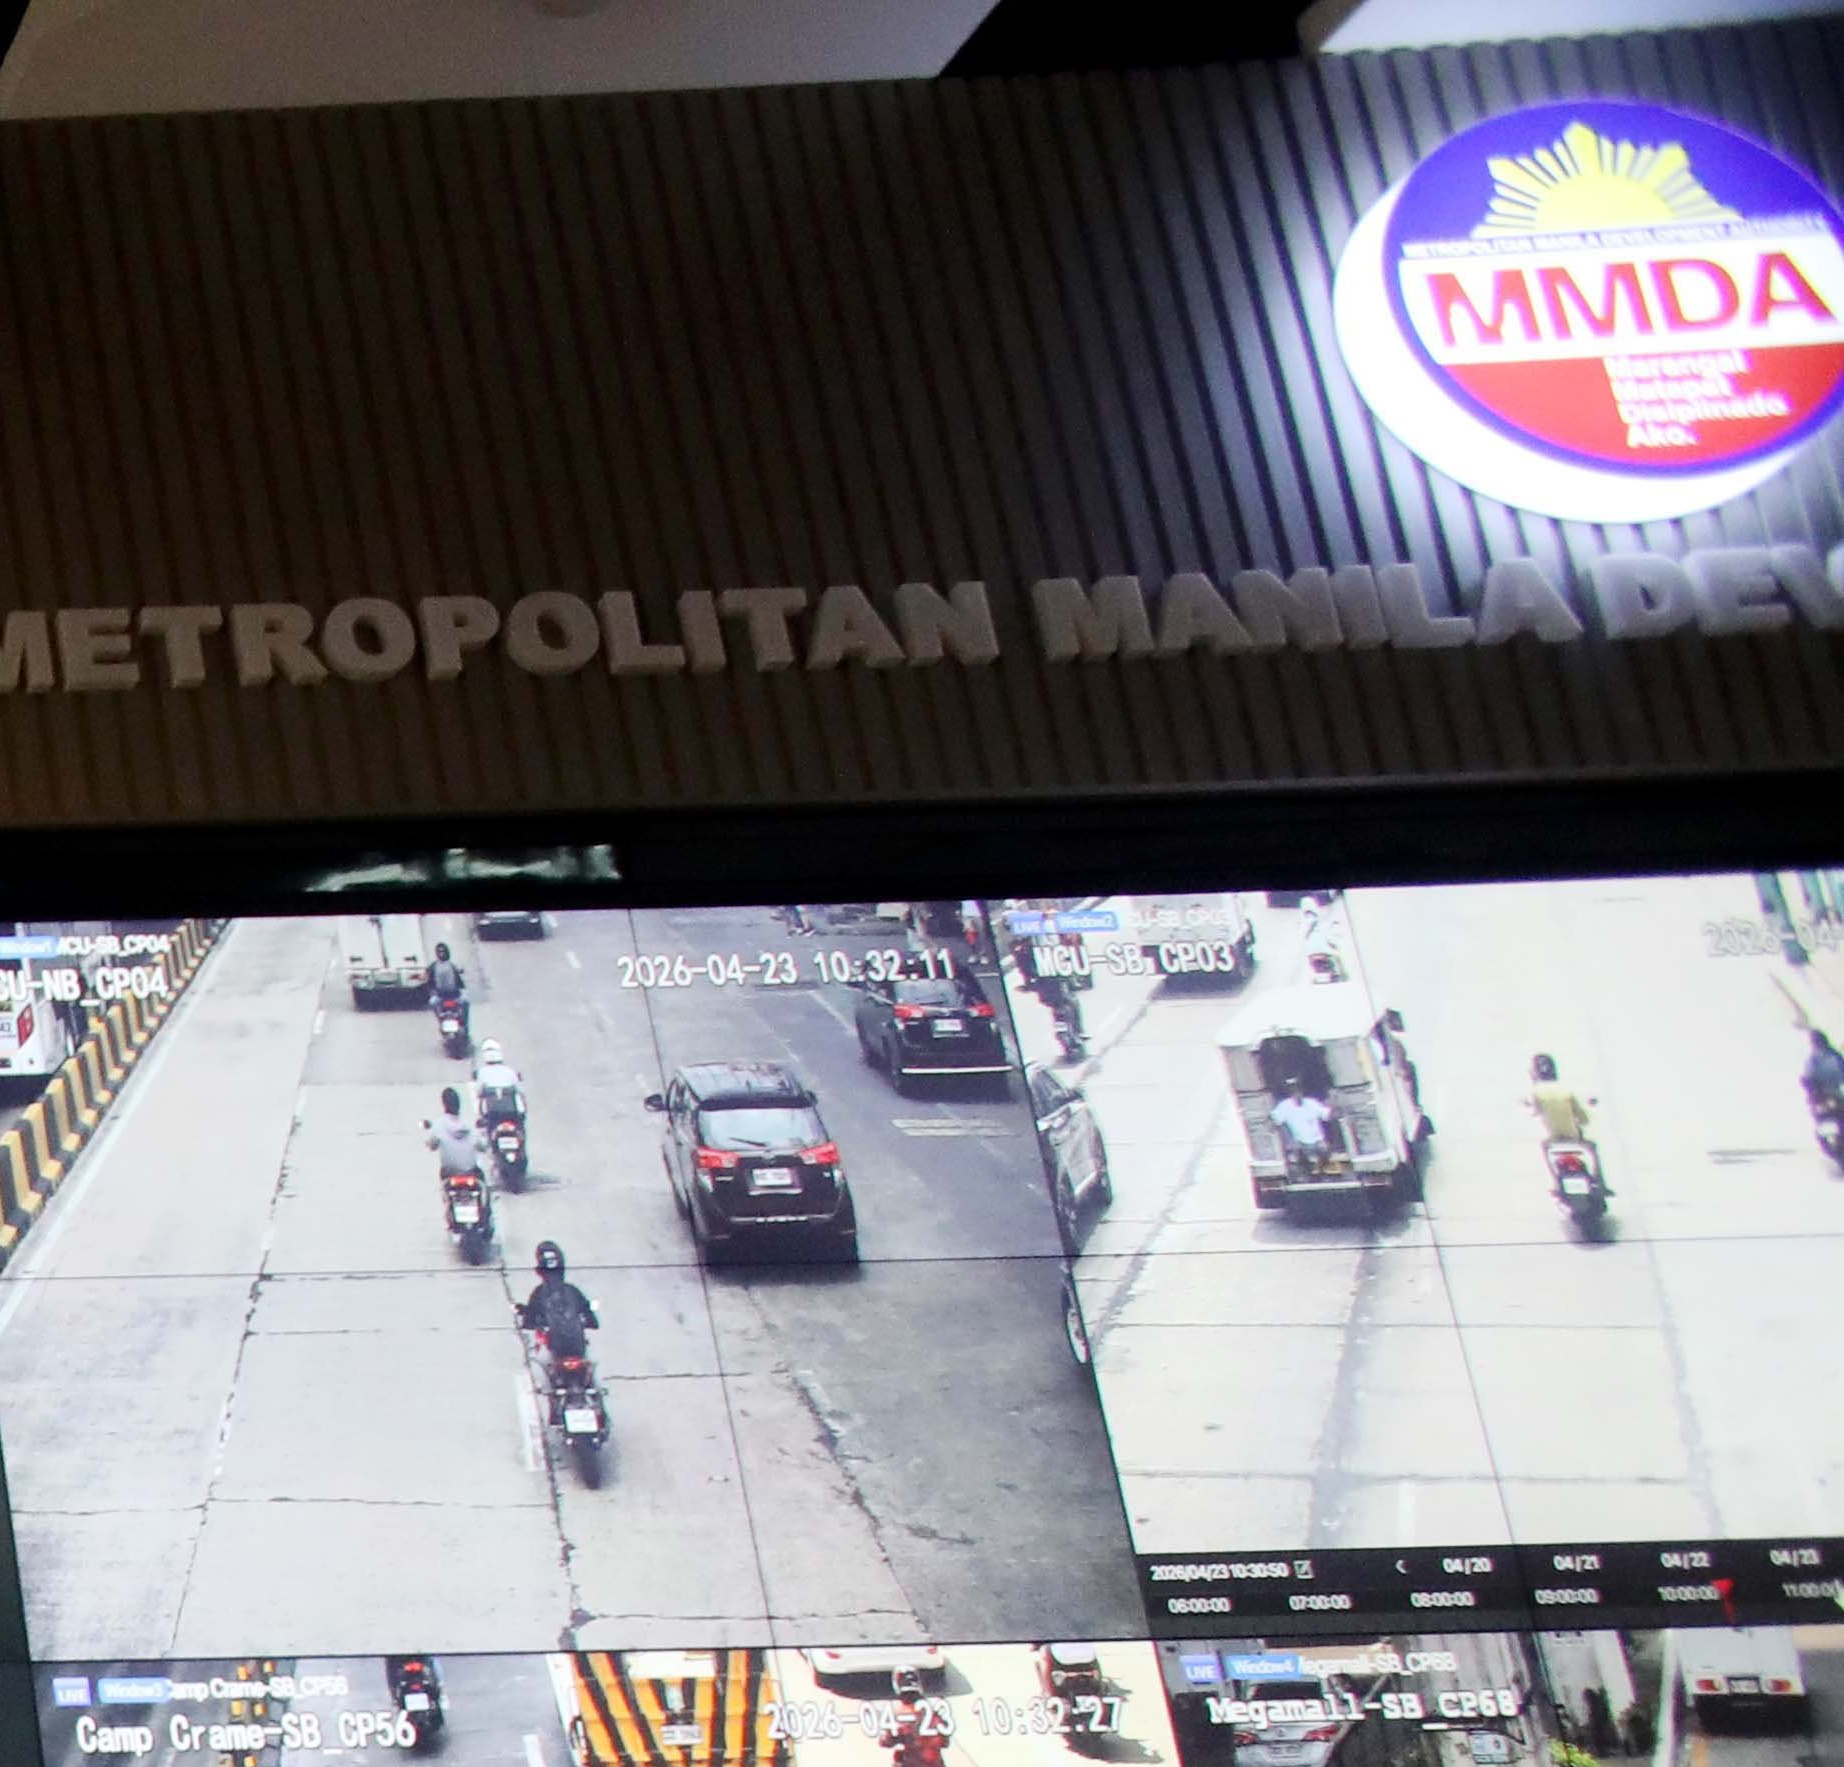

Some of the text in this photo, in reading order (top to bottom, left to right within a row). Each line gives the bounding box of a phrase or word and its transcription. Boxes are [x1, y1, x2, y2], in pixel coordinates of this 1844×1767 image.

[1425, 252, 1838, 347] MMDA
[1033, 556, 1585, 662] MANILA
[617, 951, 957, 989] 2026-04-23 10:32:11
[76, 1711, 417, 1757] Camp Crame-SB_CP56
[765, 1695, 1124, 1742] 2026-04-23 10:32:27
